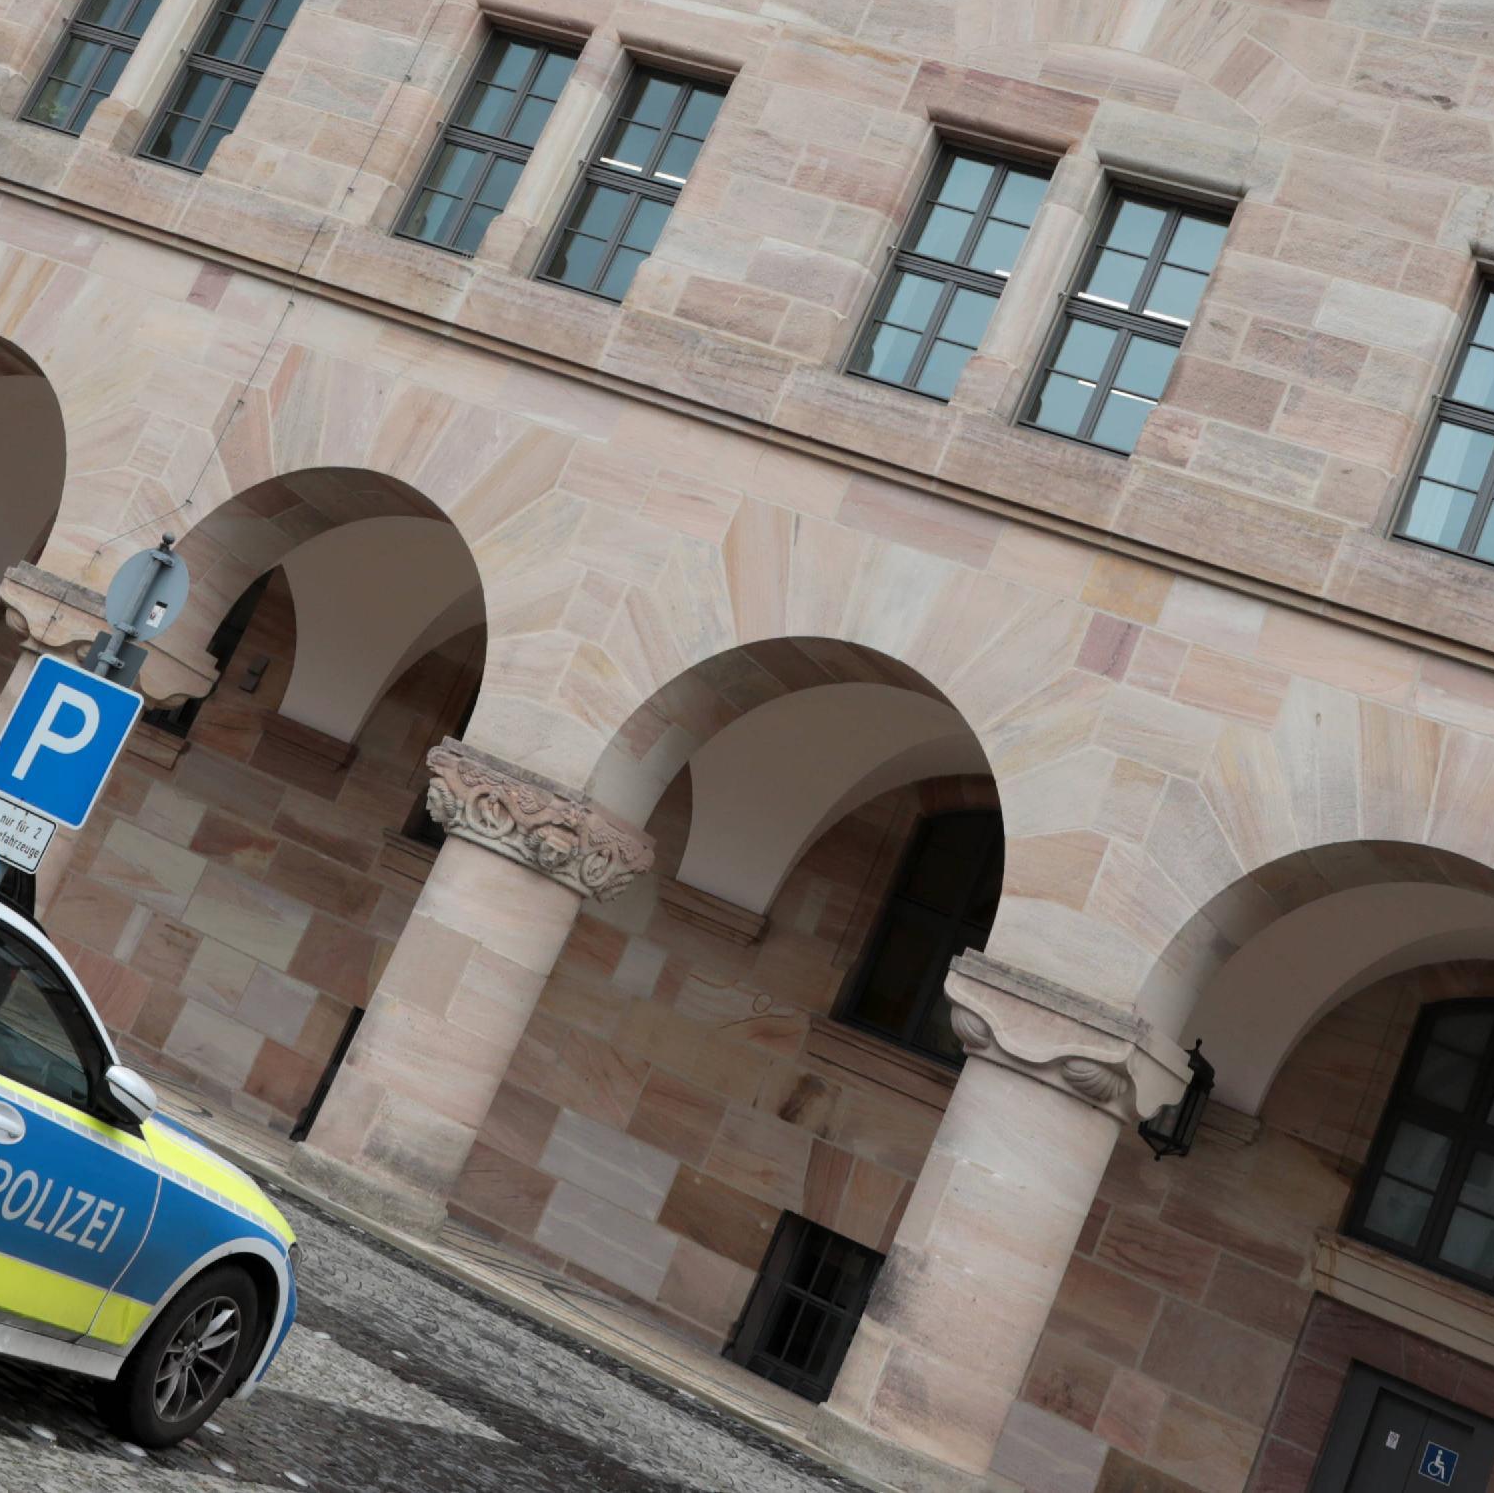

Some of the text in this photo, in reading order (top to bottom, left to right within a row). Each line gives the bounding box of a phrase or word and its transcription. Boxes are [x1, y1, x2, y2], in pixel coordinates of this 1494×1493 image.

[11, 682, 100, 781] P
[0, 814, 42, 840] nur für 2
